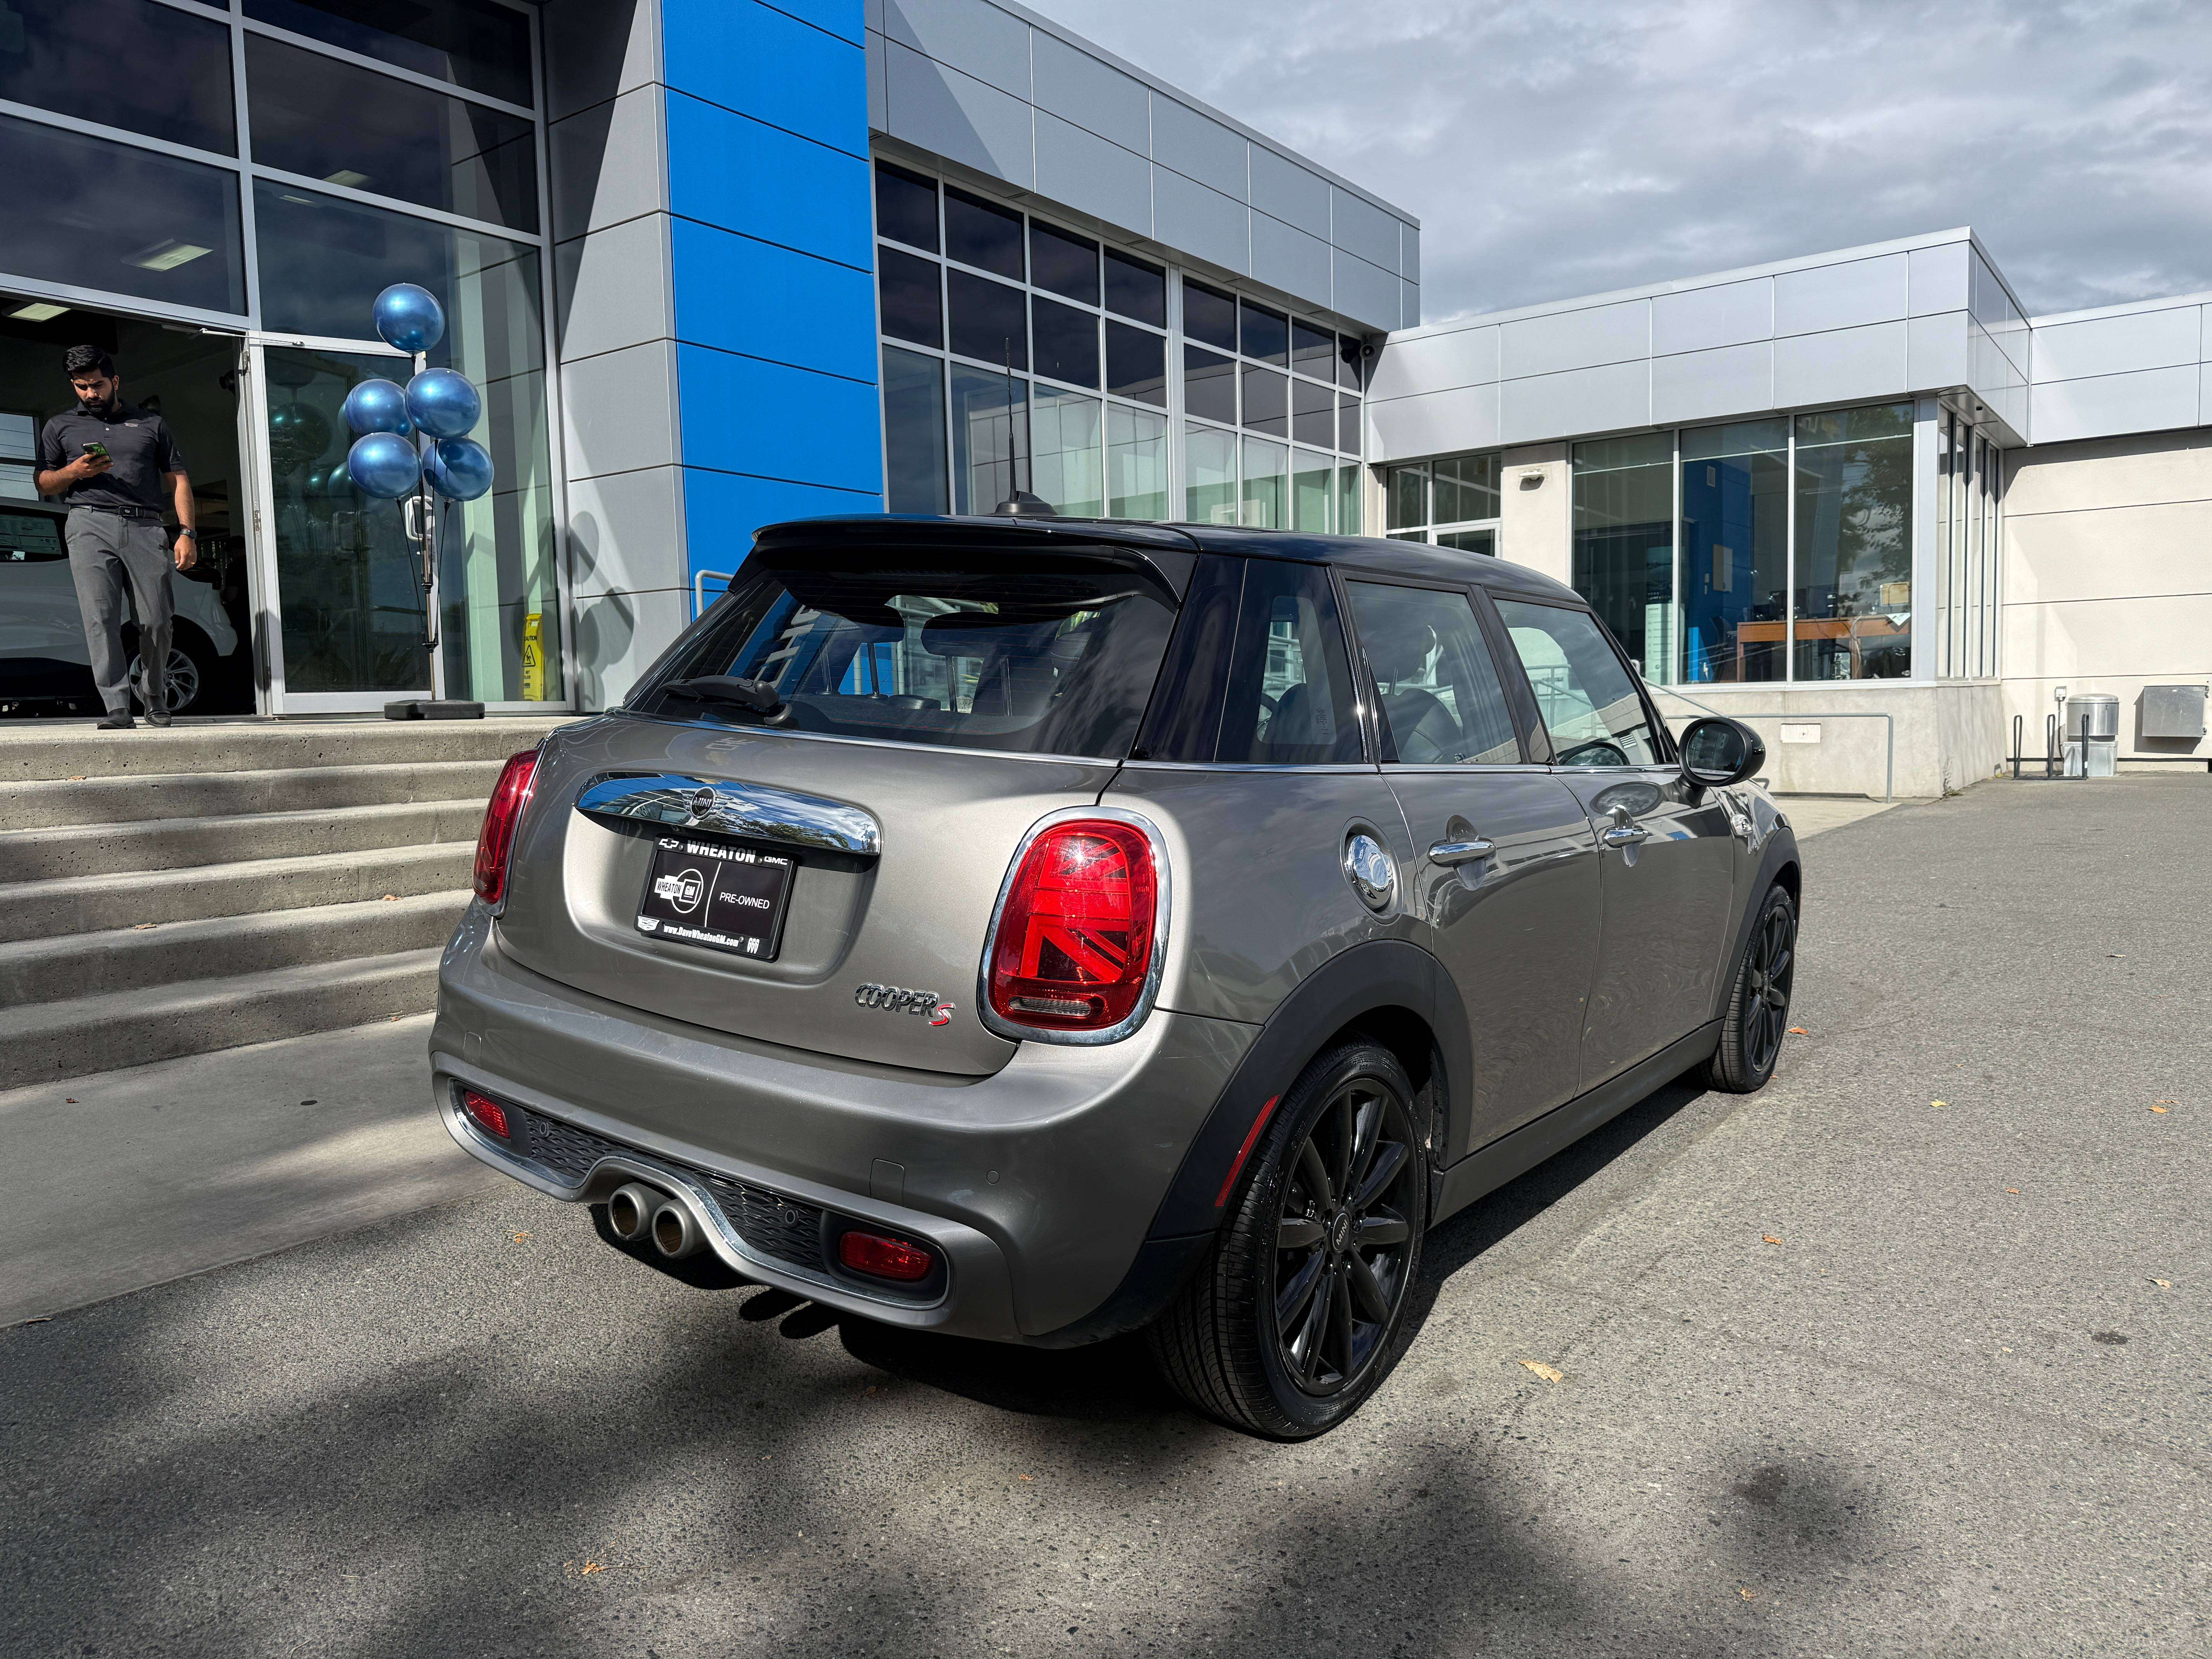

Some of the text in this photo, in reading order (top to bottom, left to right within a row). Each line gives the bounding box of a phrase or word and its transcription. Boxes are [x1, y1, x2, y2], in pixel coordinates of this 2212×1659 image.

[692, 797, 712, 807] MINI
[687, 840, 756, 864] WHEATON
[764, 856, 788, 866] GMC
[657, 881, 682, 895] WHEATON
[684, 885, 696, 896] GM
[720, 892, 770, 909] PRE-OWNED
[663, 925, 739, 947] www.DaveWheatonGM.com
[855, 982, 955, 1026] COOPER S
[1336, 1219, 1348, 1245] MINI
